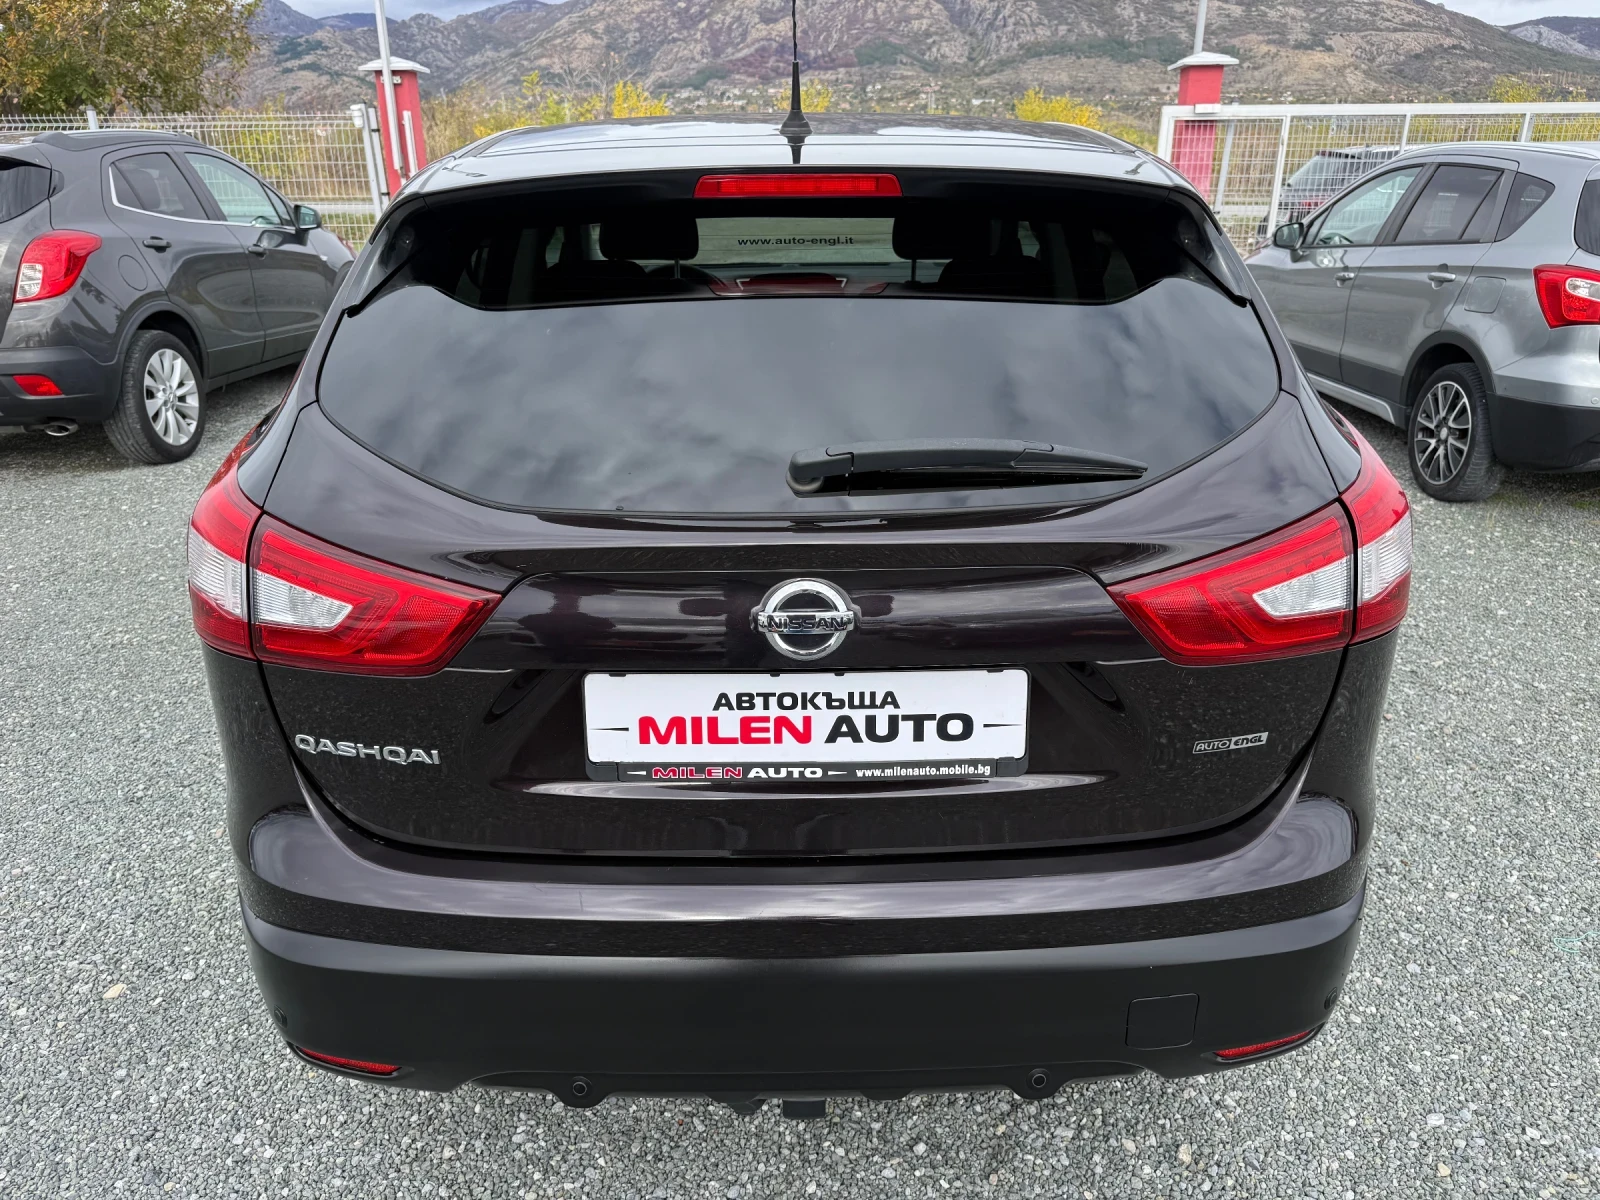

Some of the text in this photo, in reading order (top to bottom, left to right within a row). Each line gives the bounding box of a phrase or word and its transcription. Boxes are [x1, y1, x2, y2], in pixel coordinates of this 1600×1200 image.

[737, 236, 854, 246] www.auto-engl.it
[766, 615, 847, 632] NISSAN
[638, 713, 974, 745] MILEN AUTO
[294, 734, 441, 765] QASHQAI
[1196, 740, 1230, 751] AUTO
[652, 767, 823, 779] MILEN AUTO
[856, 764, 991, 778] www.milenauto.mobile.bg
